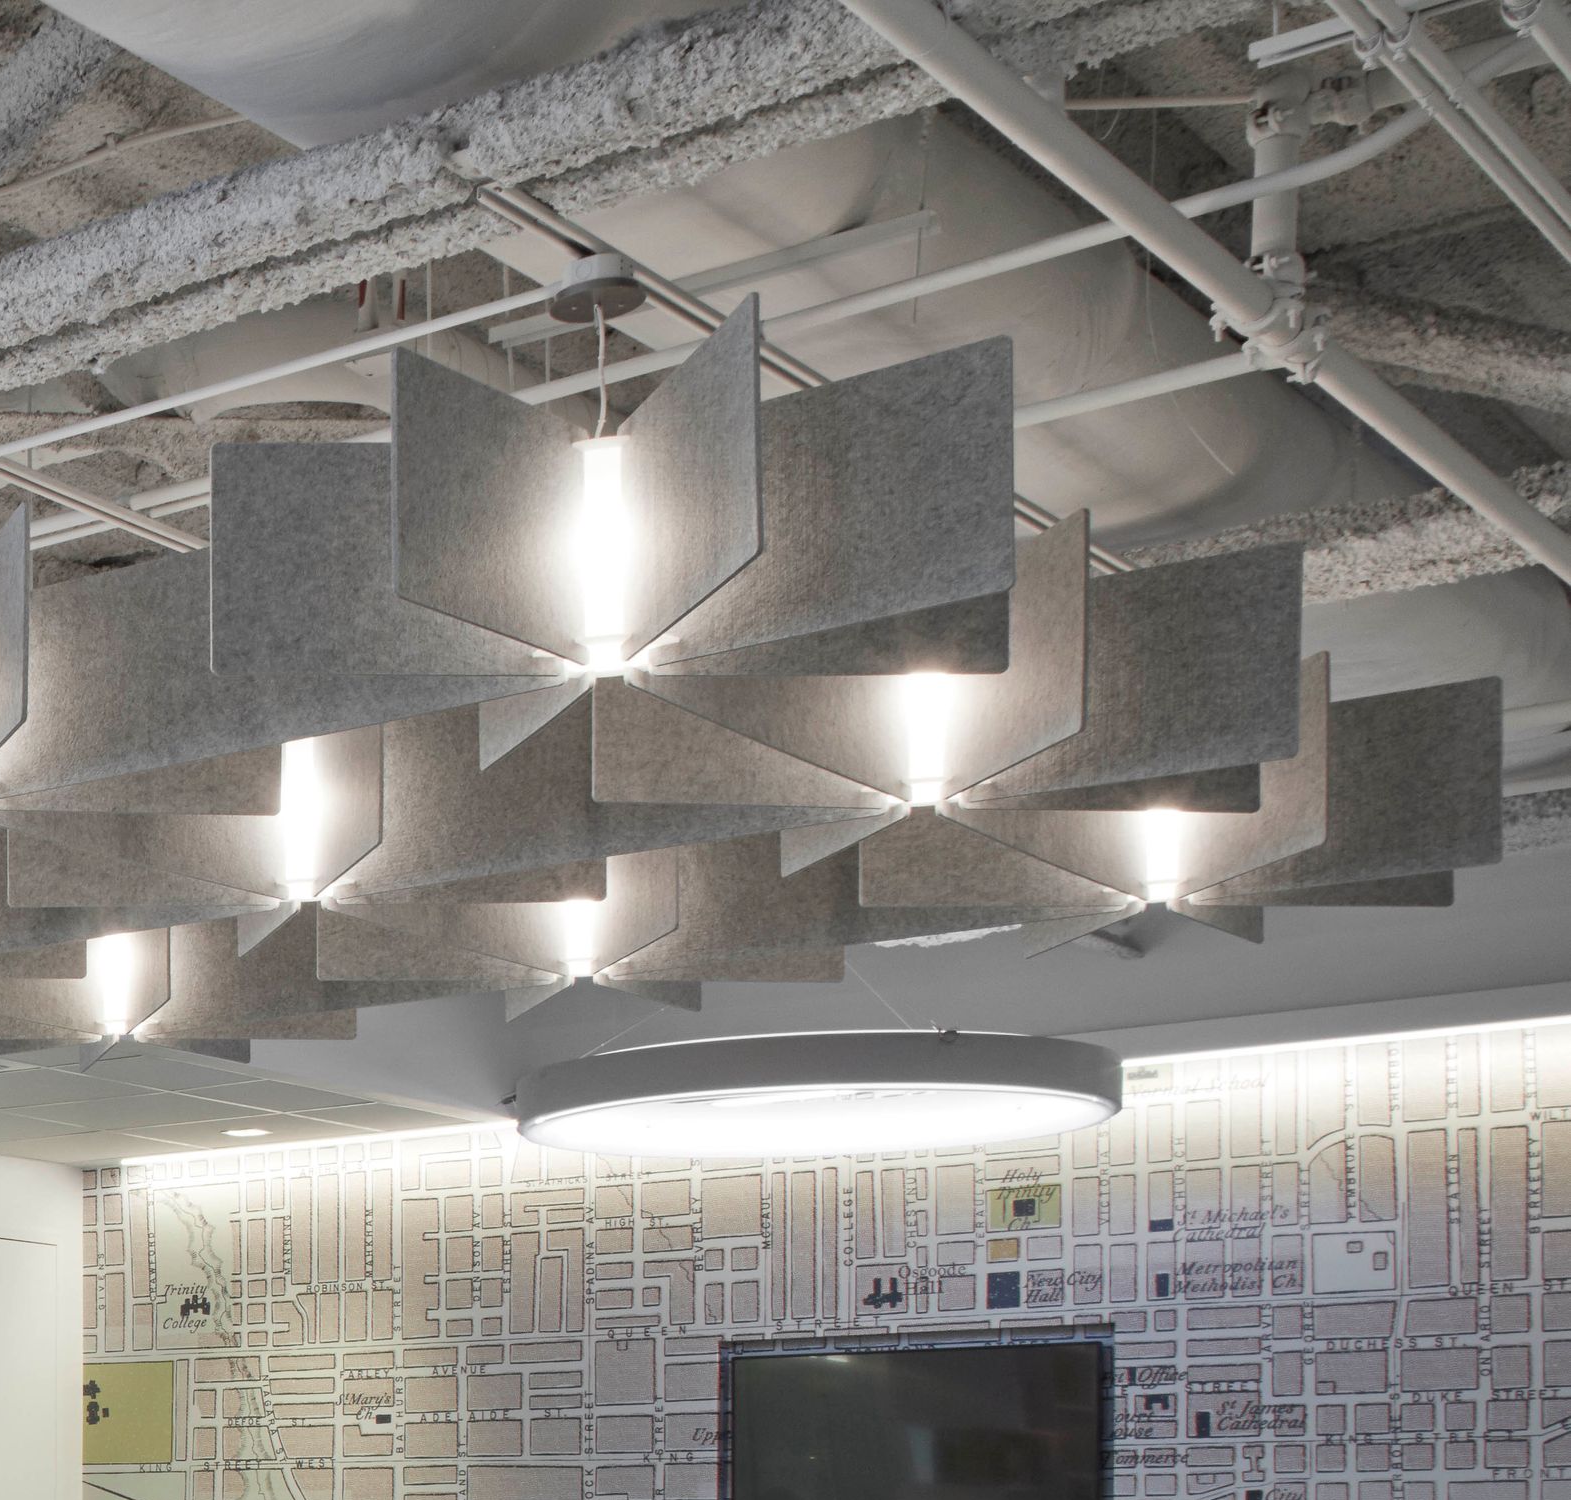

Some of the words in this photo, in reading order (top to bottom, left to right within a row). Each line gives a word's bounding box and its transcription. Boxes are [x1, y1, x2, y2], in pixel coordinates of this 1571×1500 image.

[1001, 1166, 1043, 1186] Holy
[1174, 1137, 1186, 1212] CHURCH
[1345, 1132, 1356, 1221] PEMBROKE
[1528, 1137, 1541, 1234] BERKELEY
[997, 1182, 1058, 1204] Trinity
[1100, 1151, 1110, 1226] VICTORIA
[1448, 1154, 1459, 1225] SEATON
[605, 1218, 635, 1228] HIGH
[1200, 1203, 1290, 1225] Michael's
[692, 1196, 704, 1272] BEVERLEY
[843, 1187, 853, 1267] COLLEGE
[1172, 1222, 1266, 1243] Cathedral
[1478, 1207, 1491, 1269] STREET
[283, 1214, 291, 1275] MANNING
[473, 1240, 481, 1302] DENISON
[503, 1239, 512, 1294] ESTHER
[586, 1240, 595, 1305] SPADINA
[898, 1261, 967, 1280] Osgoode
[1176, 1257, 1300, 1278] Metropolitan
[164, 1283, 207, 1299] Trinity
[306, 1281, 363, 1293] ROBINSON
[903, 1280, 946, 1296] Hall
[1024, 1273, 1063, 1289] New
[1066, 1270, 1103, 1292] City
[1171, 1274, 1265, 1295] Methodist
[1447, 1282, 1514, 1297] QUEEN
[393, 1264, 402, 1333] STREET
[1023, 1287, 1063, 1304] Hall
[162, 1316, 207, 1334] College
[607, 1326, 688, 1338] QUEEN
[775, 1316, 881, 1332] STREET
[1262, 1302, 1272, 1363] JARVIS
[1303, 1300, 1314, 1366] GEORGE
[1326, 1337, 1418, 1351] DUCHESS
[1479, 1305, 1491, 1377] ONTARIO
[339, 1369, 391, 1380] FARLEY
[432, 1365, 487, 1376] AVENUE
[262, 1374, 277, 1436] NIAGARA
[348, 1392, 393, 1411] Mary's
[1412, 1390, 1464, 1403] DUKE
[1491, 1388, 1562, 1401] STREET
[396, 1365, 404, 1454] BATHURST
[419, 1409, 510, 1423] ADELAIDE
[1238, 1400, 1296, 1421] James
[227, 1417, 261, 1428] DEFOE
[584, 1390, 594, 1455] STREET
[654, 1396, 664, 1457] STREET
[1216, 1413, 1307, 1432] Cathedral
[139, 1463, 173, 1474] KING
[203, 1460, 263, 1471] STREET
[295, 1458, 336, 1469] WEST
[642, 1452, 695, 1463] KING
[1492, 1467, 1571, 1480] FRONT
